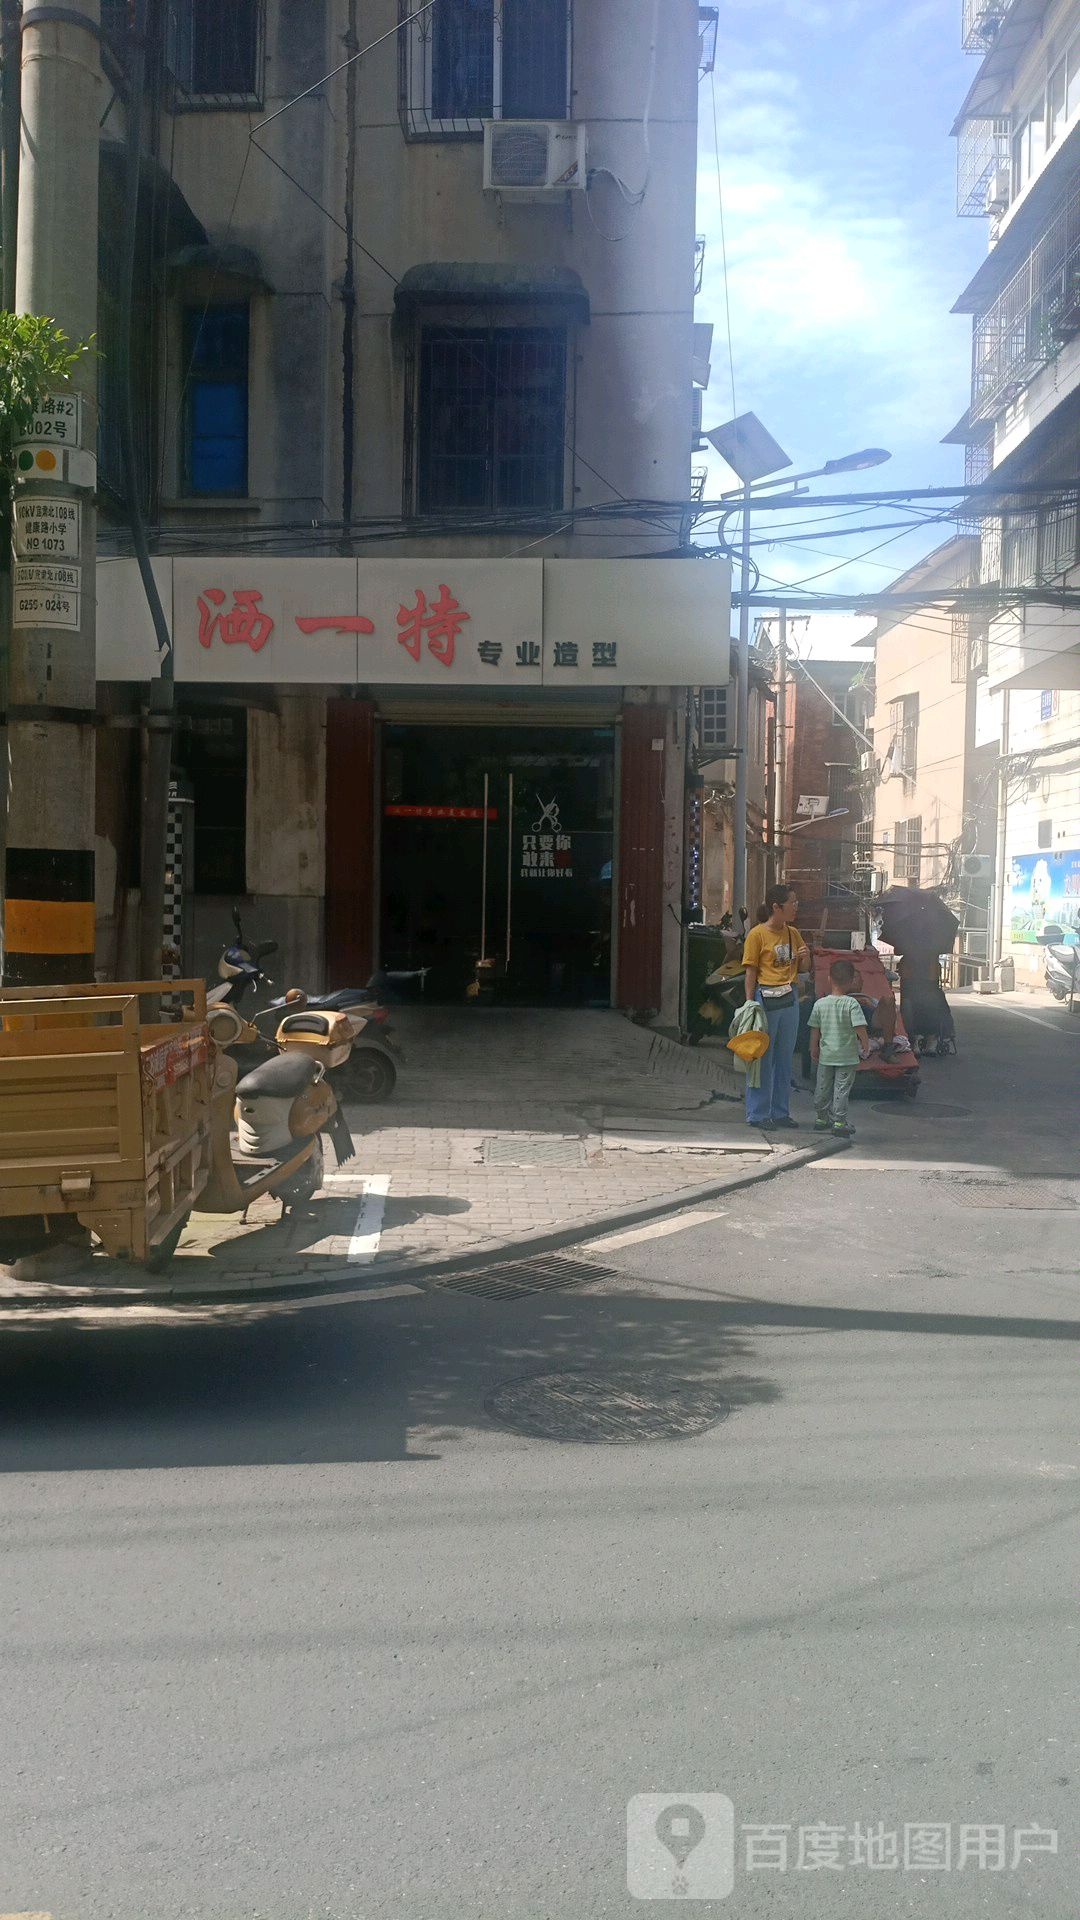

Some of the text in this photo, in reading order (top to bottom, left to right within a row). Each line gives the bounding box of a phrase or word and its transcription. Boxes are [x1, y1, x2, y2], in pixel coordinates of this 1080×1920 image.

[42, 538, 65, 551] 1073
[197, 583, 471, 668] 洒一特
[477, 640, 616, 667] 专业造型
[522, 835, 572, 850] 只要你
[522, 851, 556, 867] 敢来
